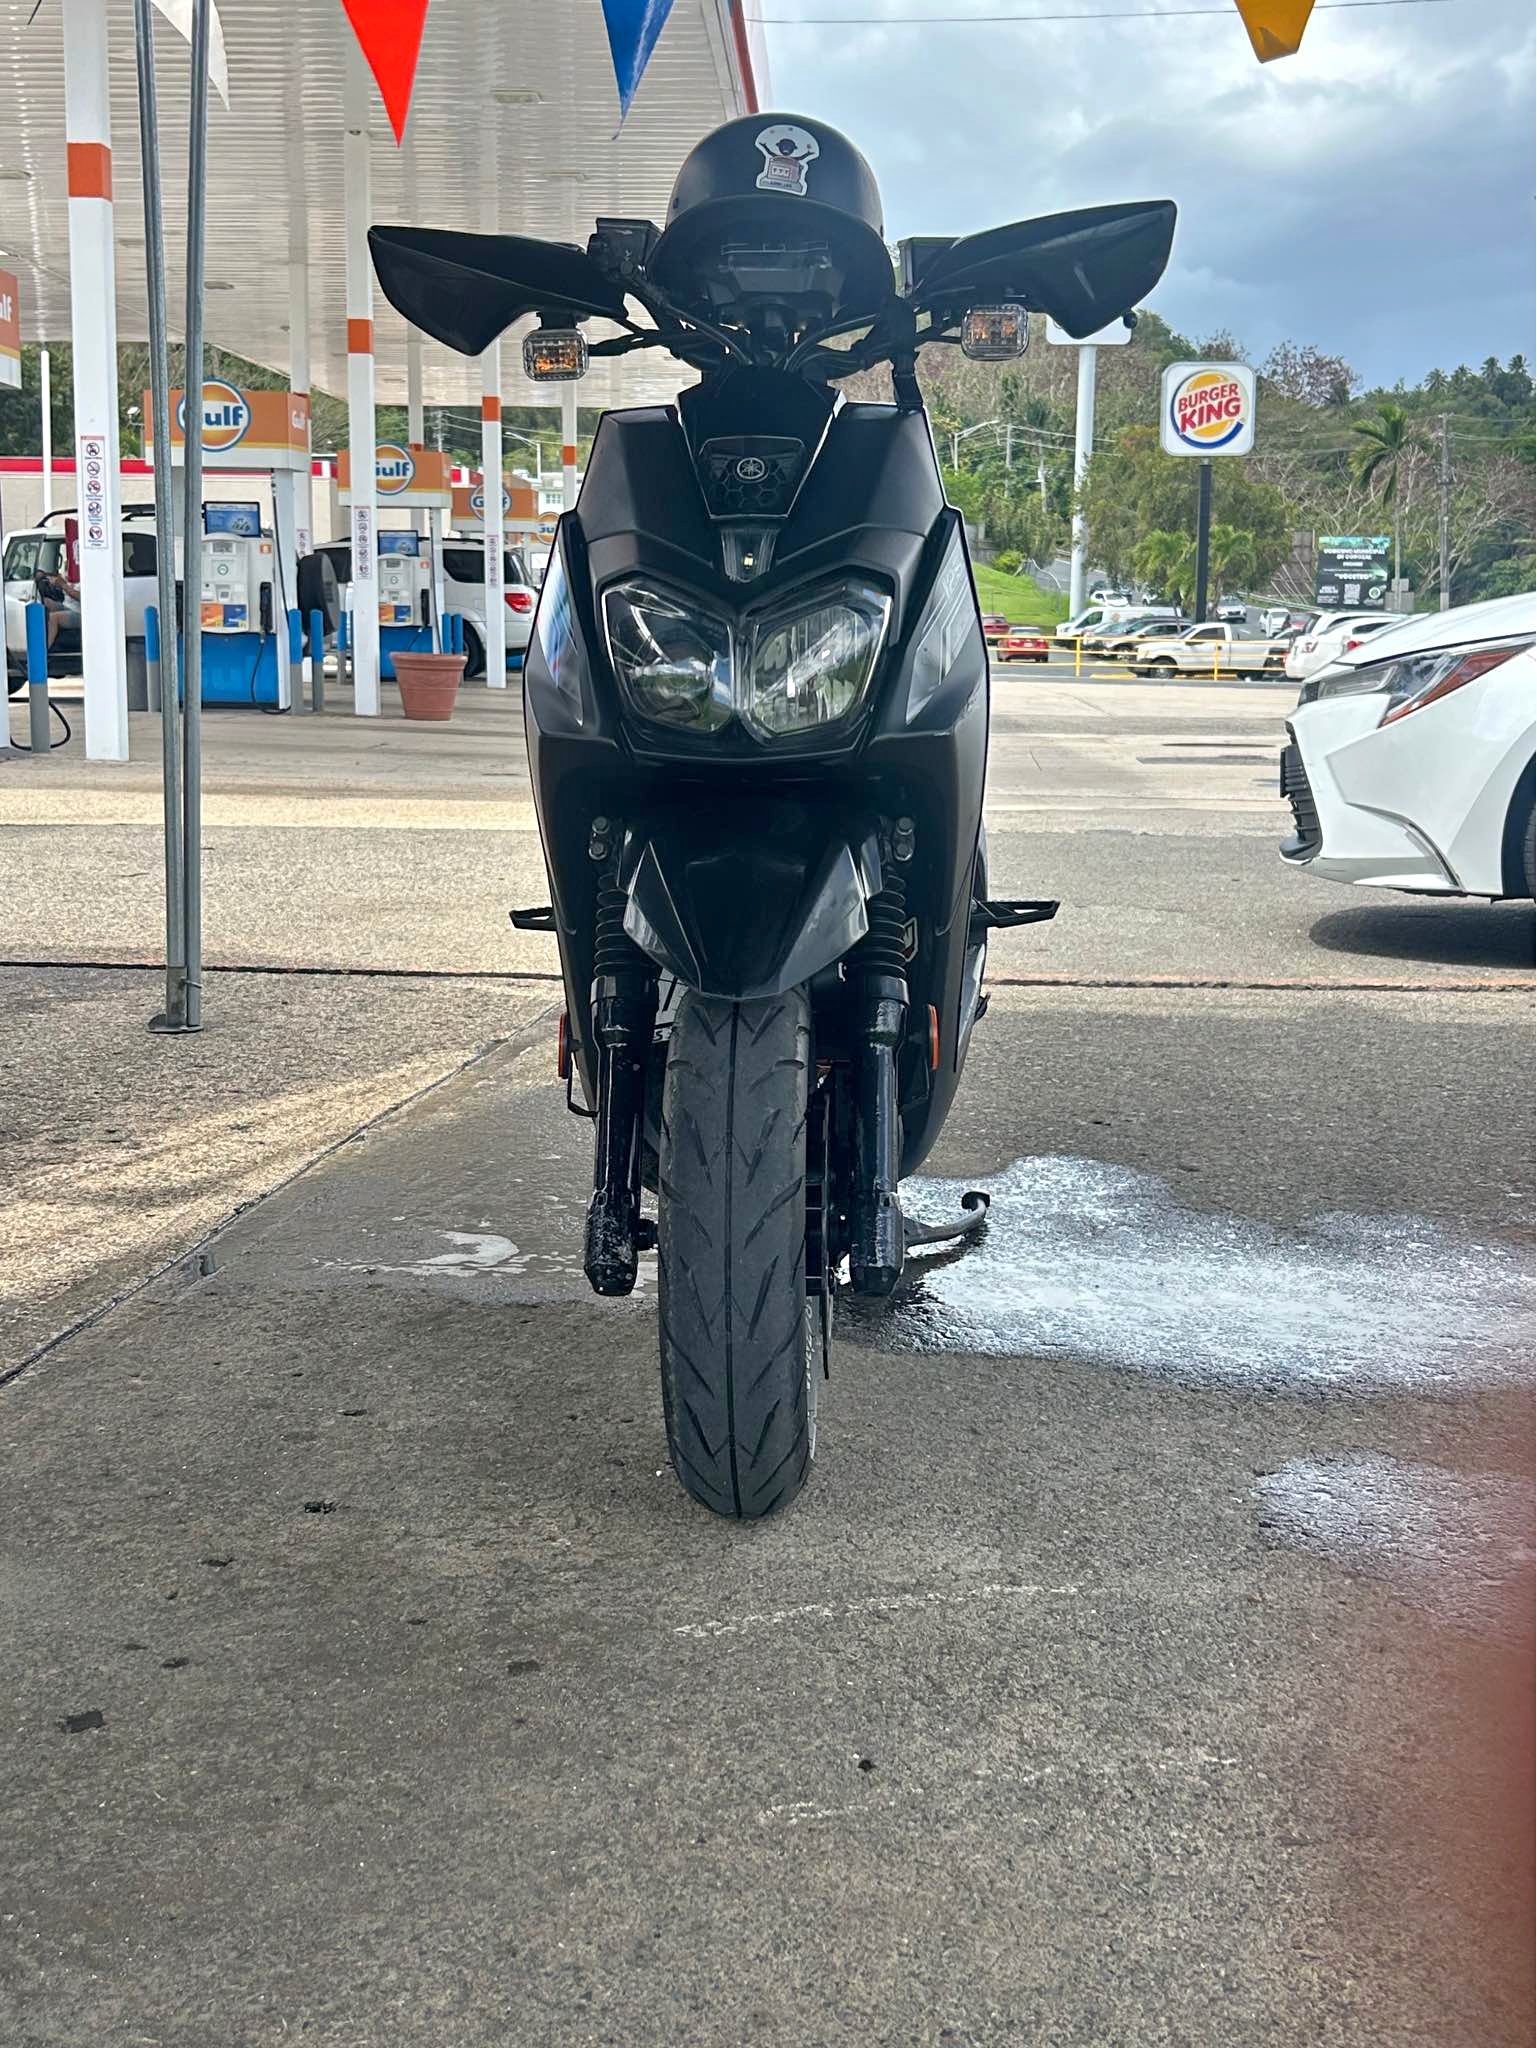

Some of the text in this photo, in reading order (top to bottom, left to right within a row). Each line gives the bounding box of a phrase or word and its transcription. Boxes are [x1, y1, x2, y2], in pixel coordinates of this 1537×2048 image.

[1178, 383, 1239, 413] BURGER
[183, 405, 244, 426] ulf
[1180, 397, 1241, 433] KING
[473, 496, 508, 509] Gf
